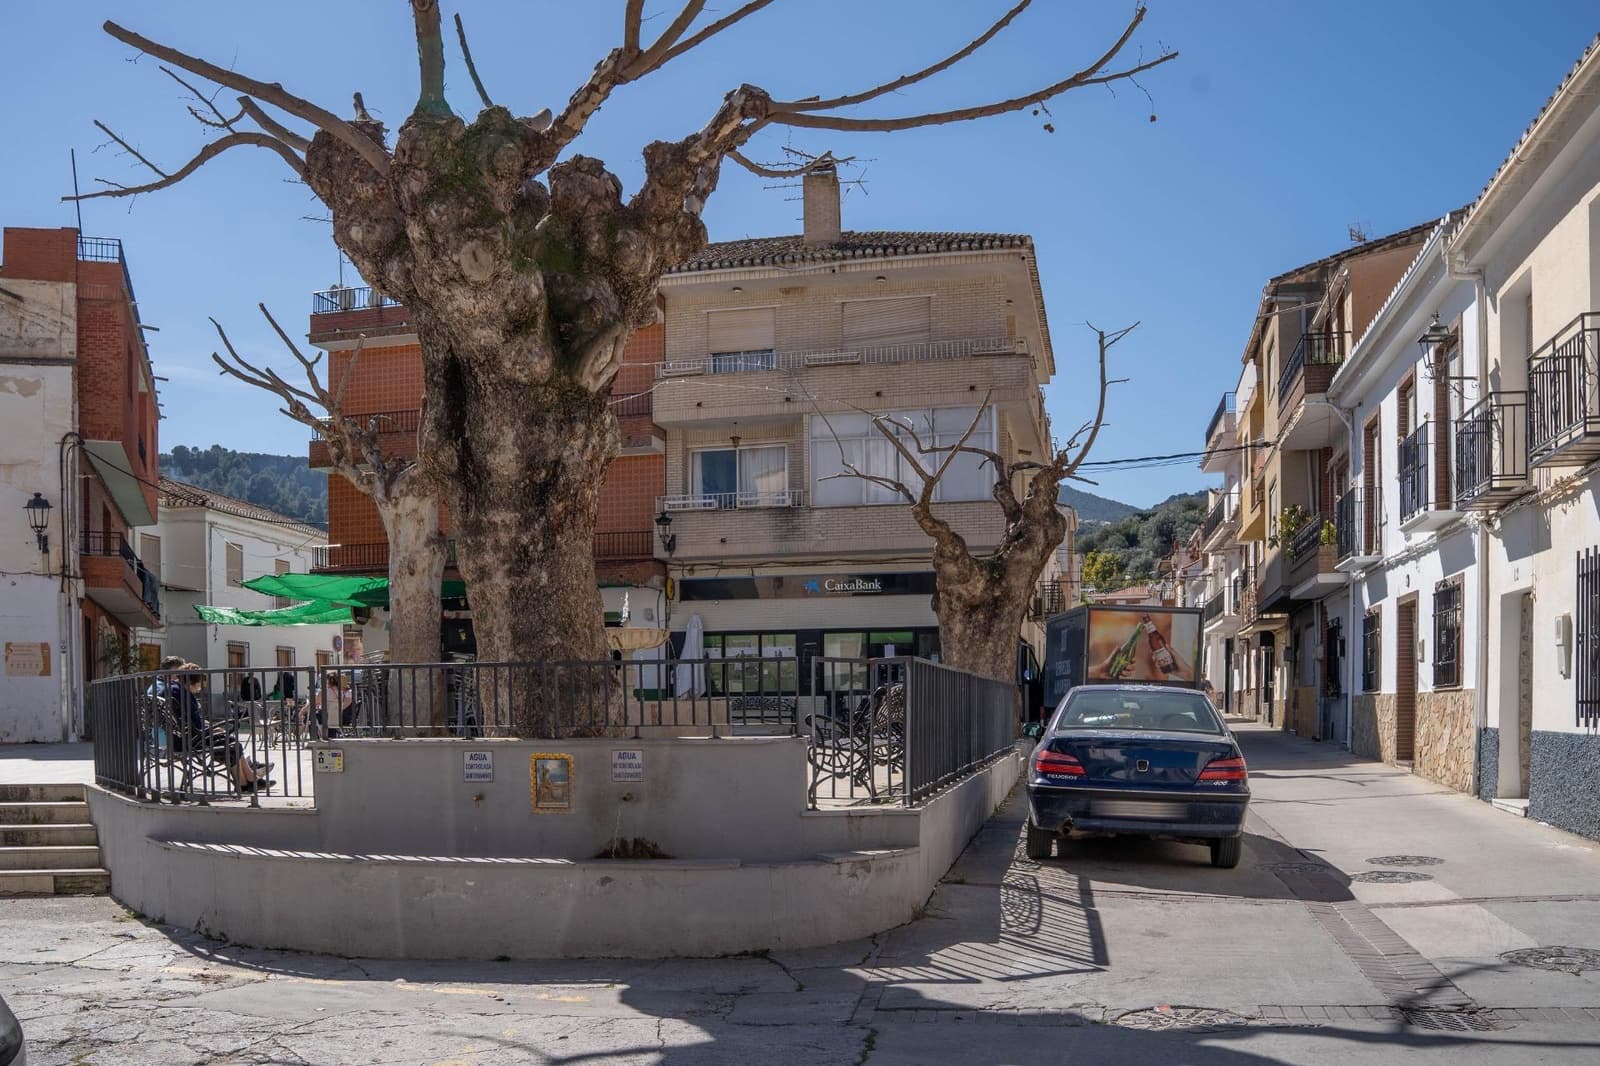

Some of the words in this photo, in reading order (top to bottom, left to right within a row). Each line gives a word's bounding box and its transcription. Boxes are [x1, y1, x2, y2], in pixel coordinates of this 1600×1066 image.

[824, 578, 882, 591] CaixaBank
[469, 753, 487, 761] AGUA
[617, 752, 636, 760] AGUA
